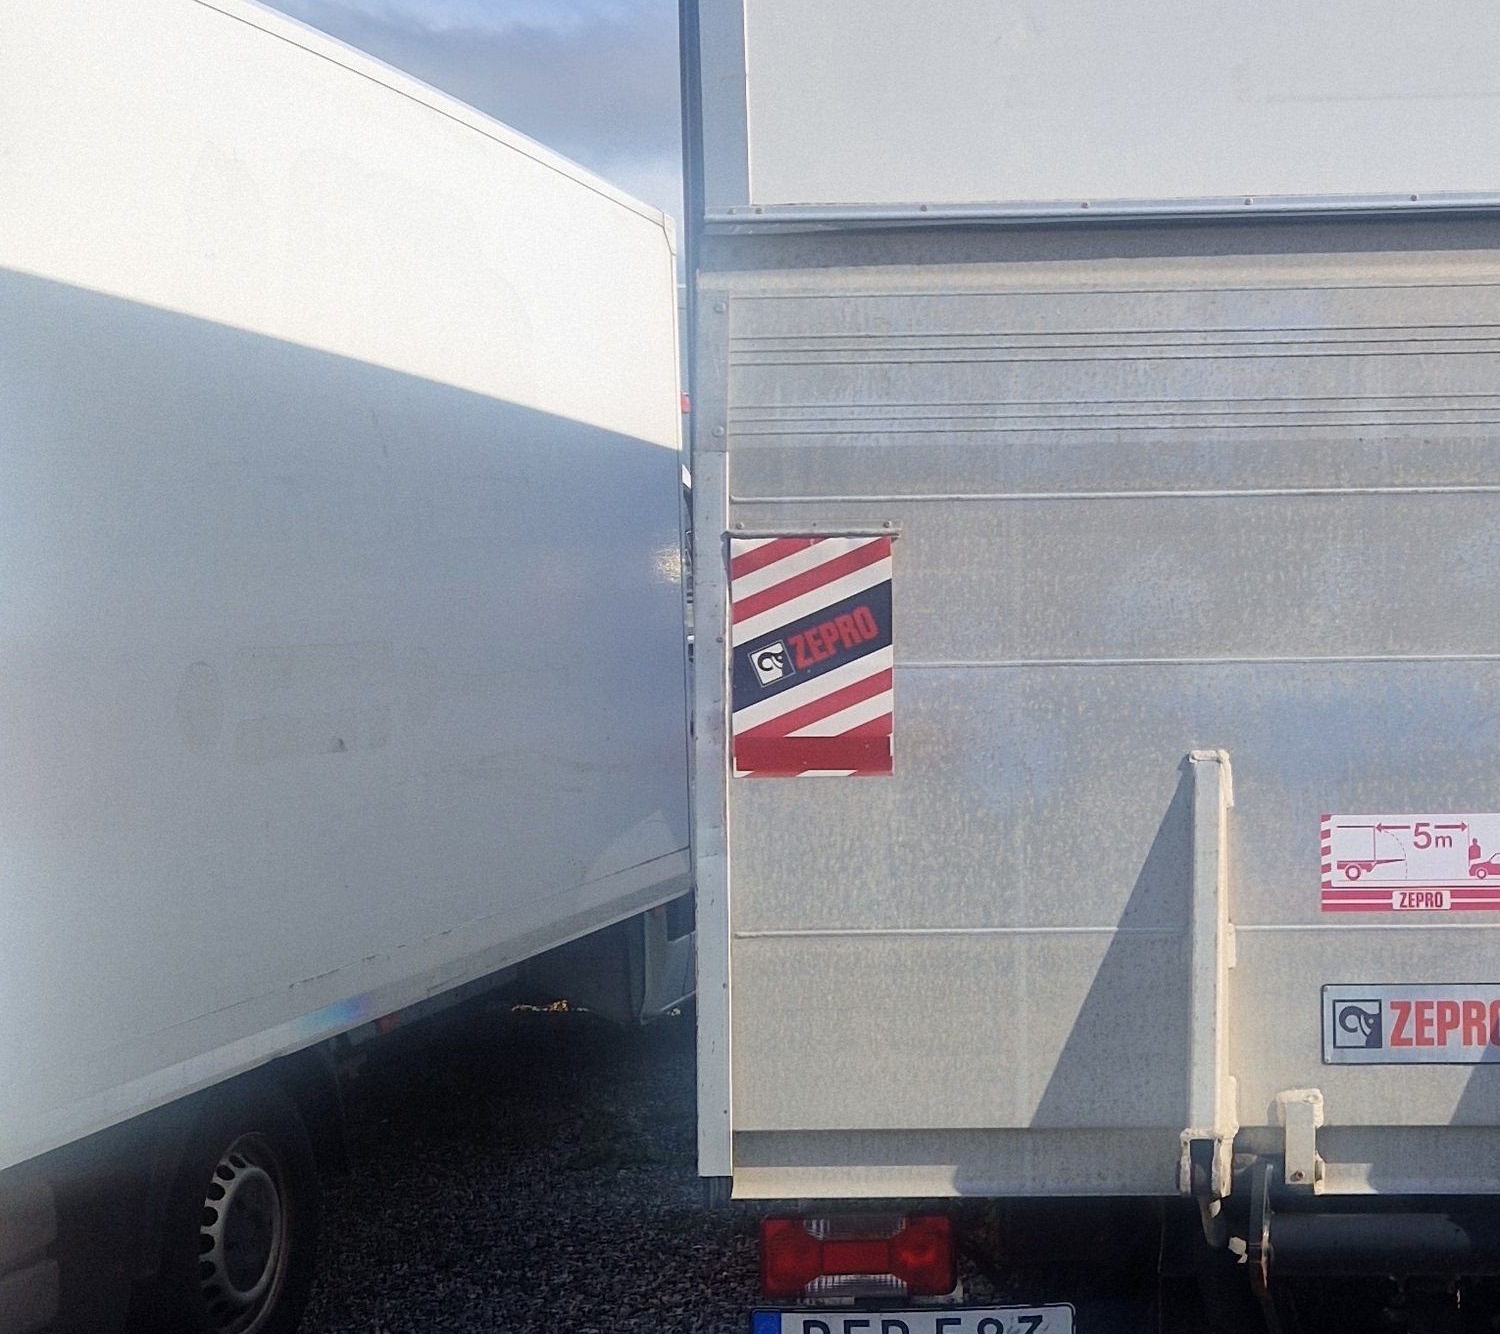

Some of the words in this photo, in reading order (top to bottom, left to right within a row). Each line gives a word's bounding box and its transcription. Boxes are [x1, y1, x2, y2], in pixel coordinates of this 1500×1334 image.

[787, 605, 879, 670] ZEPRO
[1413, 823, 1432, 850] 5
[1434, 833, 1453, 849] m
[1399, 892, 1444, 908] ZEPRO
